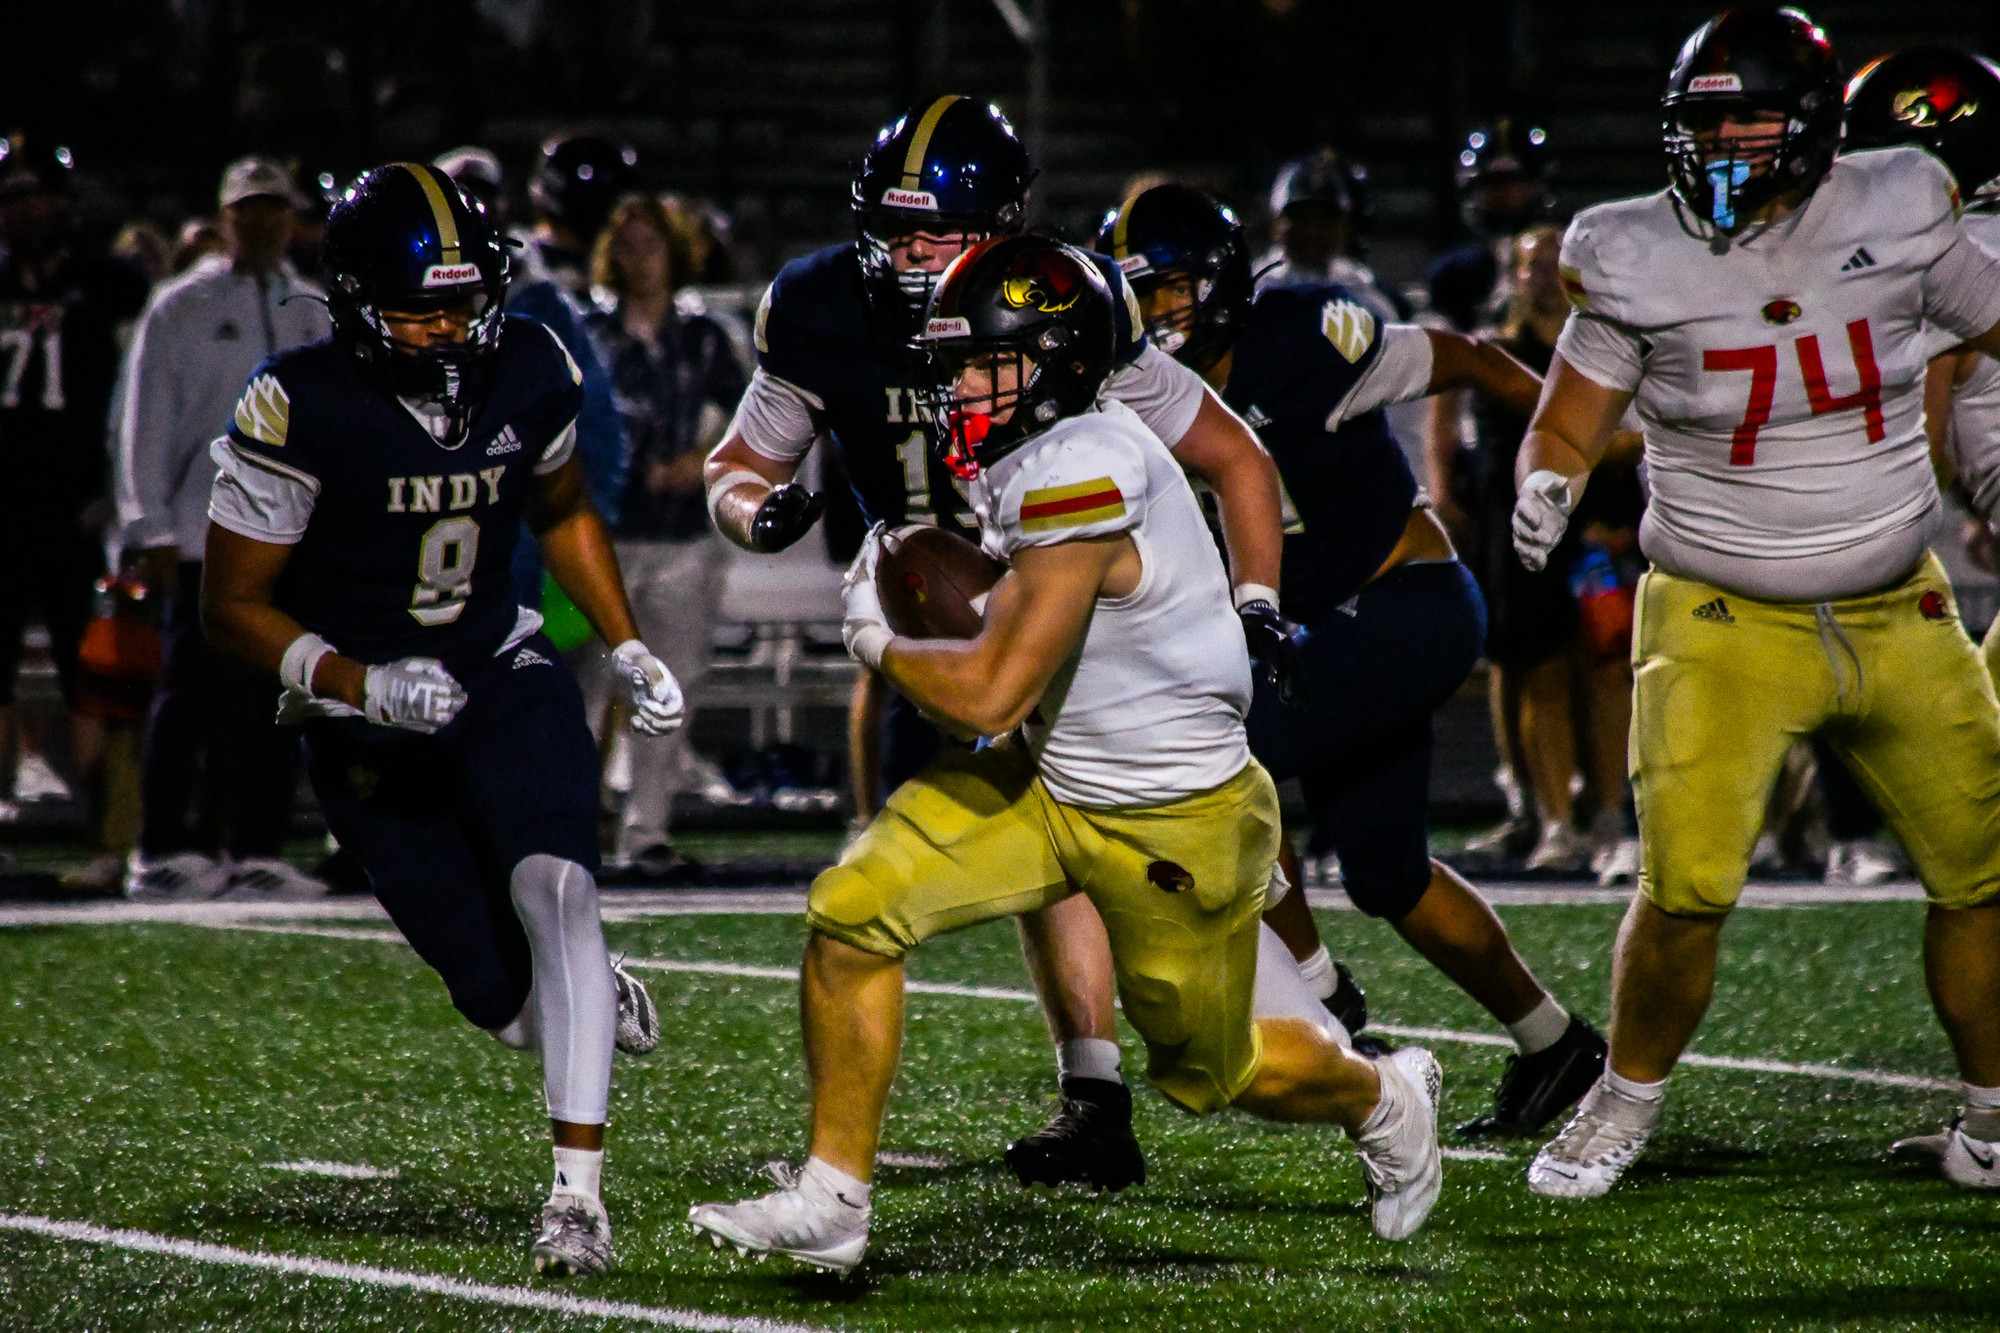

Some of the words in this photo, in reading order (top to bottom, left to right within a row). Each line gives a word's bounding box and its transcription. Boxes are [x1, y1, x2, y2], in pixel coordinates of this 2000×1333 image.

[1693, 77, 1734, 89] Riddell
[888, 193, 930, 206] Riddell
[432, 267, 475, 280] Riddell
[0, 329, 64, 409] 71
[1703, 318, 1886, 466] 74
[485, 440, 522, 456] adidas
[387, 465, 506, 513] INDY
[407, 515, 481, 626] 8
